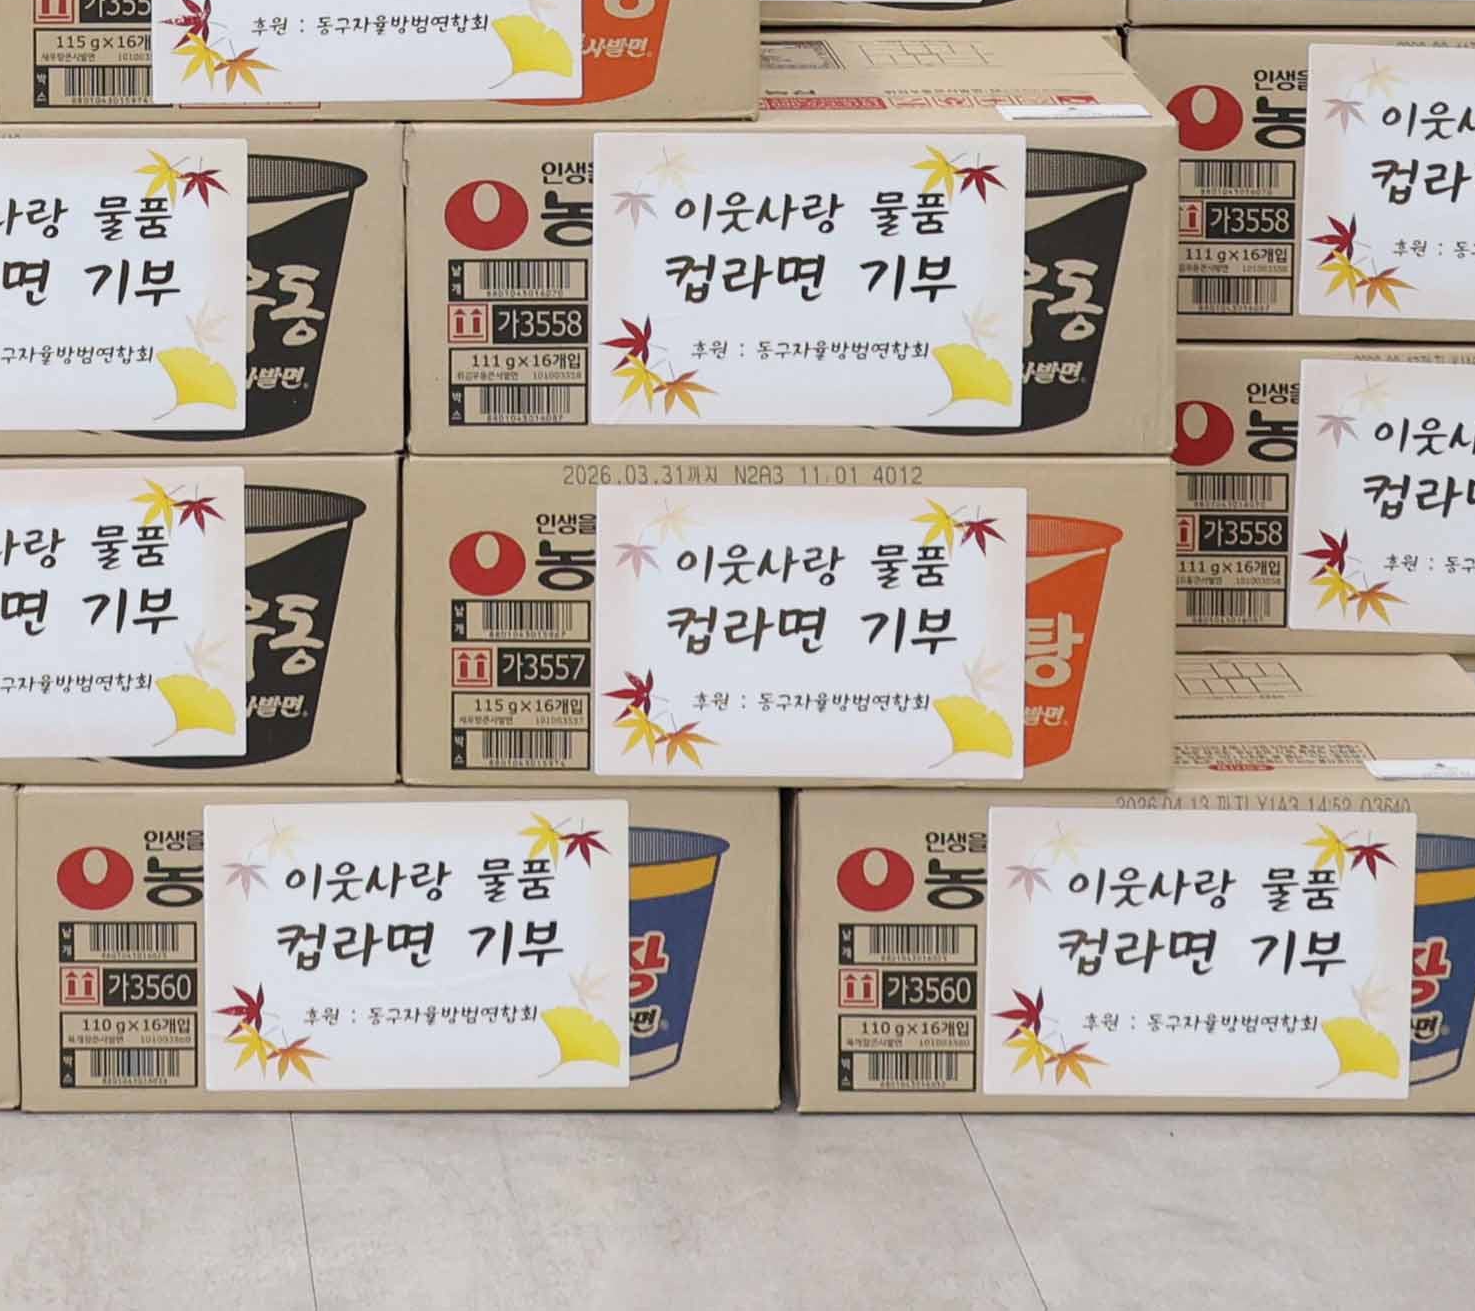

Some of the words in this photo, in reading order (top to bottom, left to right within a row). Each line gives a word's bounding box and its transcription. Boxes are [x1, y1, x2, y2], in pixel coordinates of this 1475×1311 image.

[251, 16, 288, 36] 후원
[316, 13, 489, 36] 동구자율방범연합회
[582, 35, 648, 59] 사발면
[93, 196, 172, 242] 물품
[675, 191, 845, 234] 이웃사랑
[870, 191, 949, 237] 물품
[1393, 238, 1427, 258] 후원
[84, 259, 181, 307] 기부
[665, 254, 826, 304] 컵라면
[859, 254, 957, 303] 기부
[91, 525, 169, 570] 물품
[676, 544, 845, 587] 이웃사랑
[870, 544, 949, 590] 물품
[82, 587, 179, 635] 기부
[667, 606, 827, 655] 컵라면
[860, 607, 957, 655] 기부
[502, 651, 587, 683] 가3557
[285, 861, 452, 903] 이웃사랑
[477, 858, 555, 903] 물품
[1068, 867, 1236, 909] 이웃사랑
[1261, 868, 1339, 912] 물품
[277, 921, 435, 972] 컵라면
[468, 920, 564, 967] 기부
[1058, 928, 1217, 977] 컵라면
[1251, 930, 1347, 978] 기부
[109, 971, 192, 1003] 가3560
[888, 974, 971, 1007] 가3560
[1083, 1013, 1119, 1032] 후원
[1148, 1013, 1318, 1034] 동구자율방범연합회
